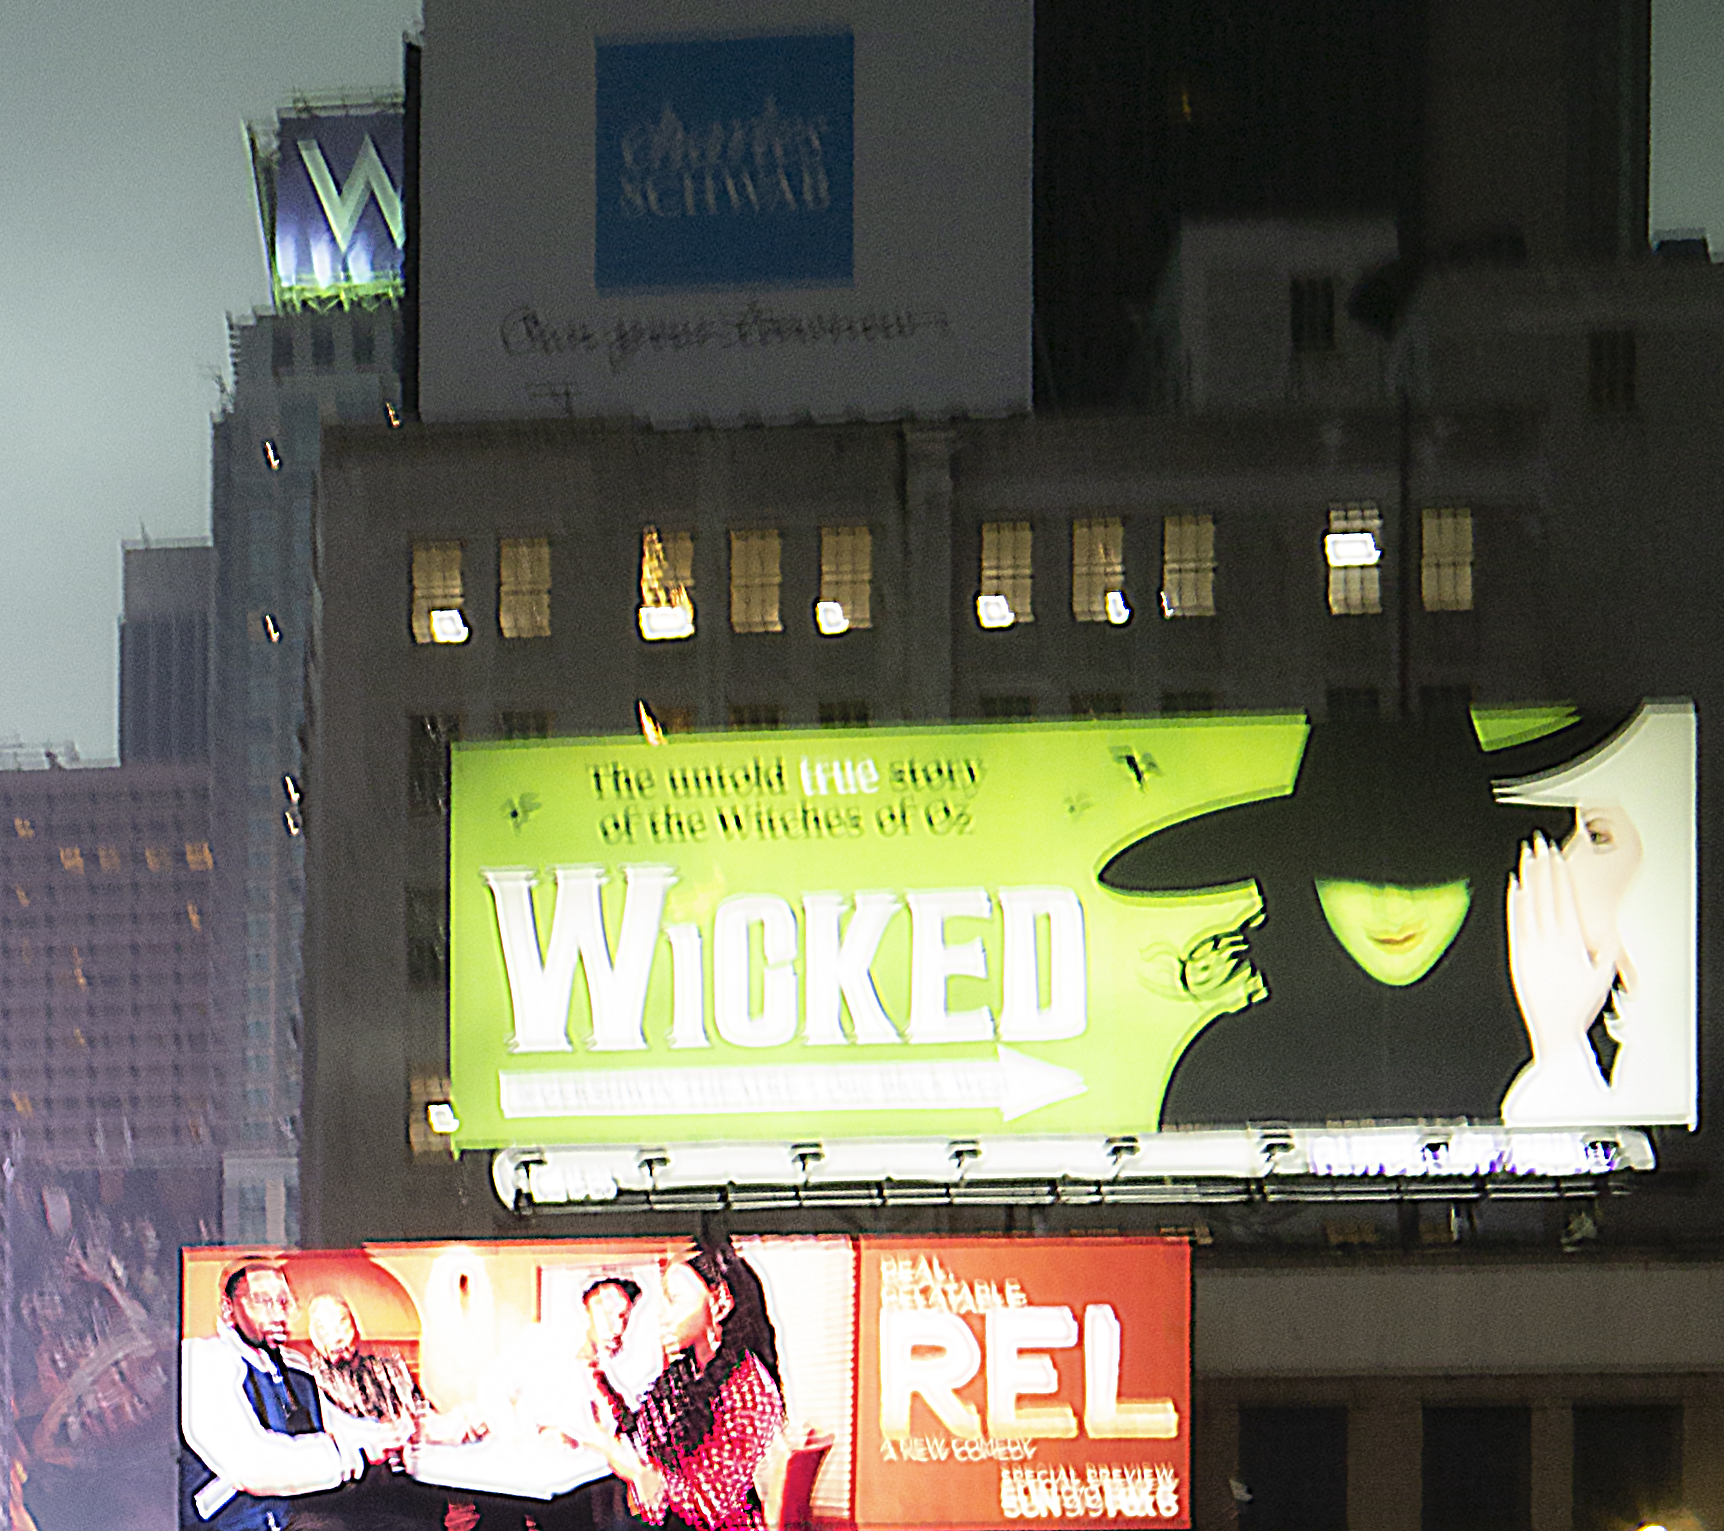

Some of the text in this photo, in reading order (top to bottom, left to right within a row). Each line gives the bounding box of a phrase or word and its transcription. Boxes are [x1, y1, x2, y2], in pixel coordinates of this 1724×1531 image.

[297, 134, 404, 252] W
[590, 756, 982, 800] The untold true story
[599, 796, 975, 845] of the Witches of Oz
[878, 1304, 1179, 1438] REL
[880, 1437, 1036, 1462] A NEW COMEDY
[1001, 1465, 1175, 1485] SPECIAL PREVIEW
